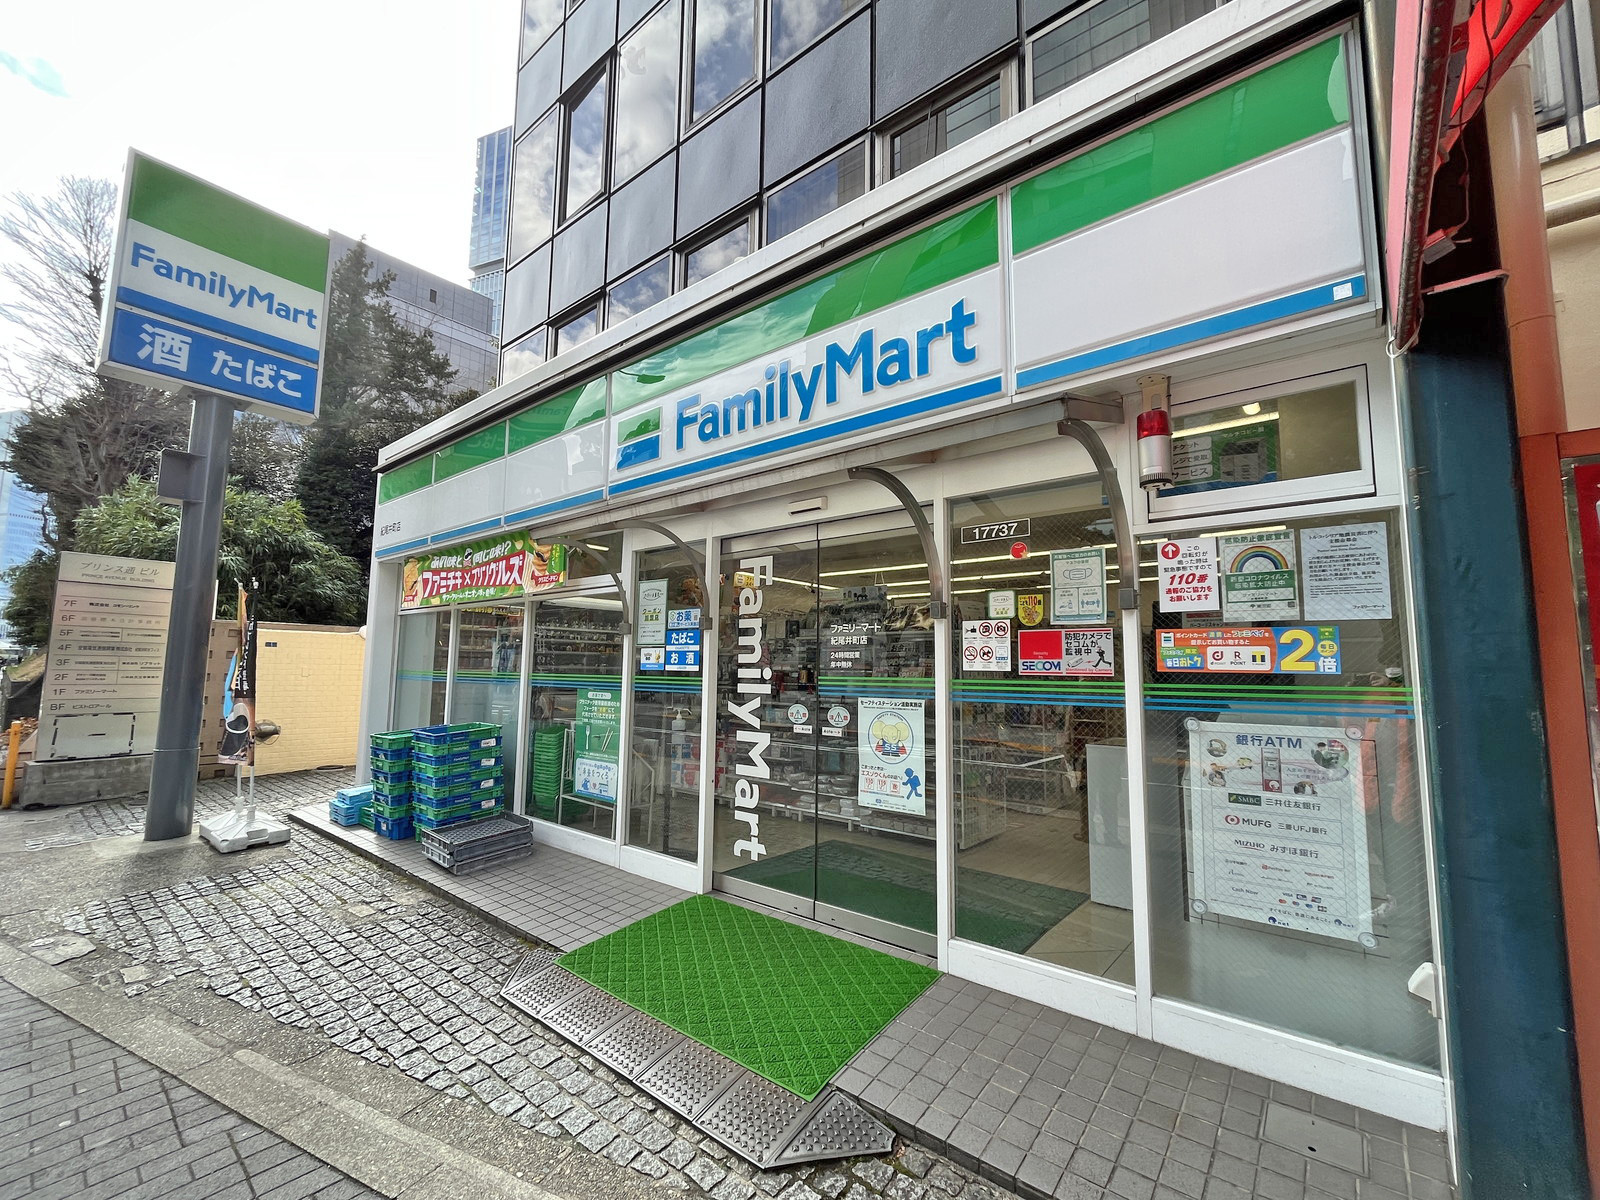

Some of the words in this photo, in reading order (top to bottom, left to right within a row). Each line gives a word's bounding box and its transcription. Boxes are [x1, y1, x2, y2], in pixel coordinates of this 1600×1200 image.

[131, 242, 318, 330] FamilyMart
[137, 323, 192, 373] 酒
[210, 349, 302, 399] たばこ
[676, 297, 977, 451] FamilyMart
[973, 523, 1017, 539] 17737
[140, 567, 160, 576] ビル
[1164, 564, 1212, 573] 緊急事態ですので
[1169, 572, 1209, 585] 110番
[1230, 573, 1289, 582] 新型コロナウイルス
[1166, 585, 1213, 594] 通報のご協力を
[1169, 594, 1210, 602] お願いします
[831, 622, 881, 633] ファミリーマート
[671, 632, 694, 644] たばこ
[831, 636, 867, 645] 紀尾井町店
[1065, 632, 1111, 640] 防犯カメラで
[1065, 640, 1098, 648] セコムが
[1065, 648, 1092, 656] 監視中
[1280, 629, 1316, 671] 2
[1318, 656, 1337, 672] 倍
[1022, 661, 1060, 671] SECOM
[727, 555, 773, 861] FamilyMart
[1236, 734, 1302, 749] 銀行ATM
[1238, 796, 1260, 804] SMBC
[1265, 799, 1321, 811] 三井住友銀行
[1242, 818, 1272, 828] MUFG
[1277, 822, 1327, 835] 三菱UFJ銀行
[1234, 839, 1265, 849] MIZUHO
[1270, 845, 1319, 859] みずほ銀行
